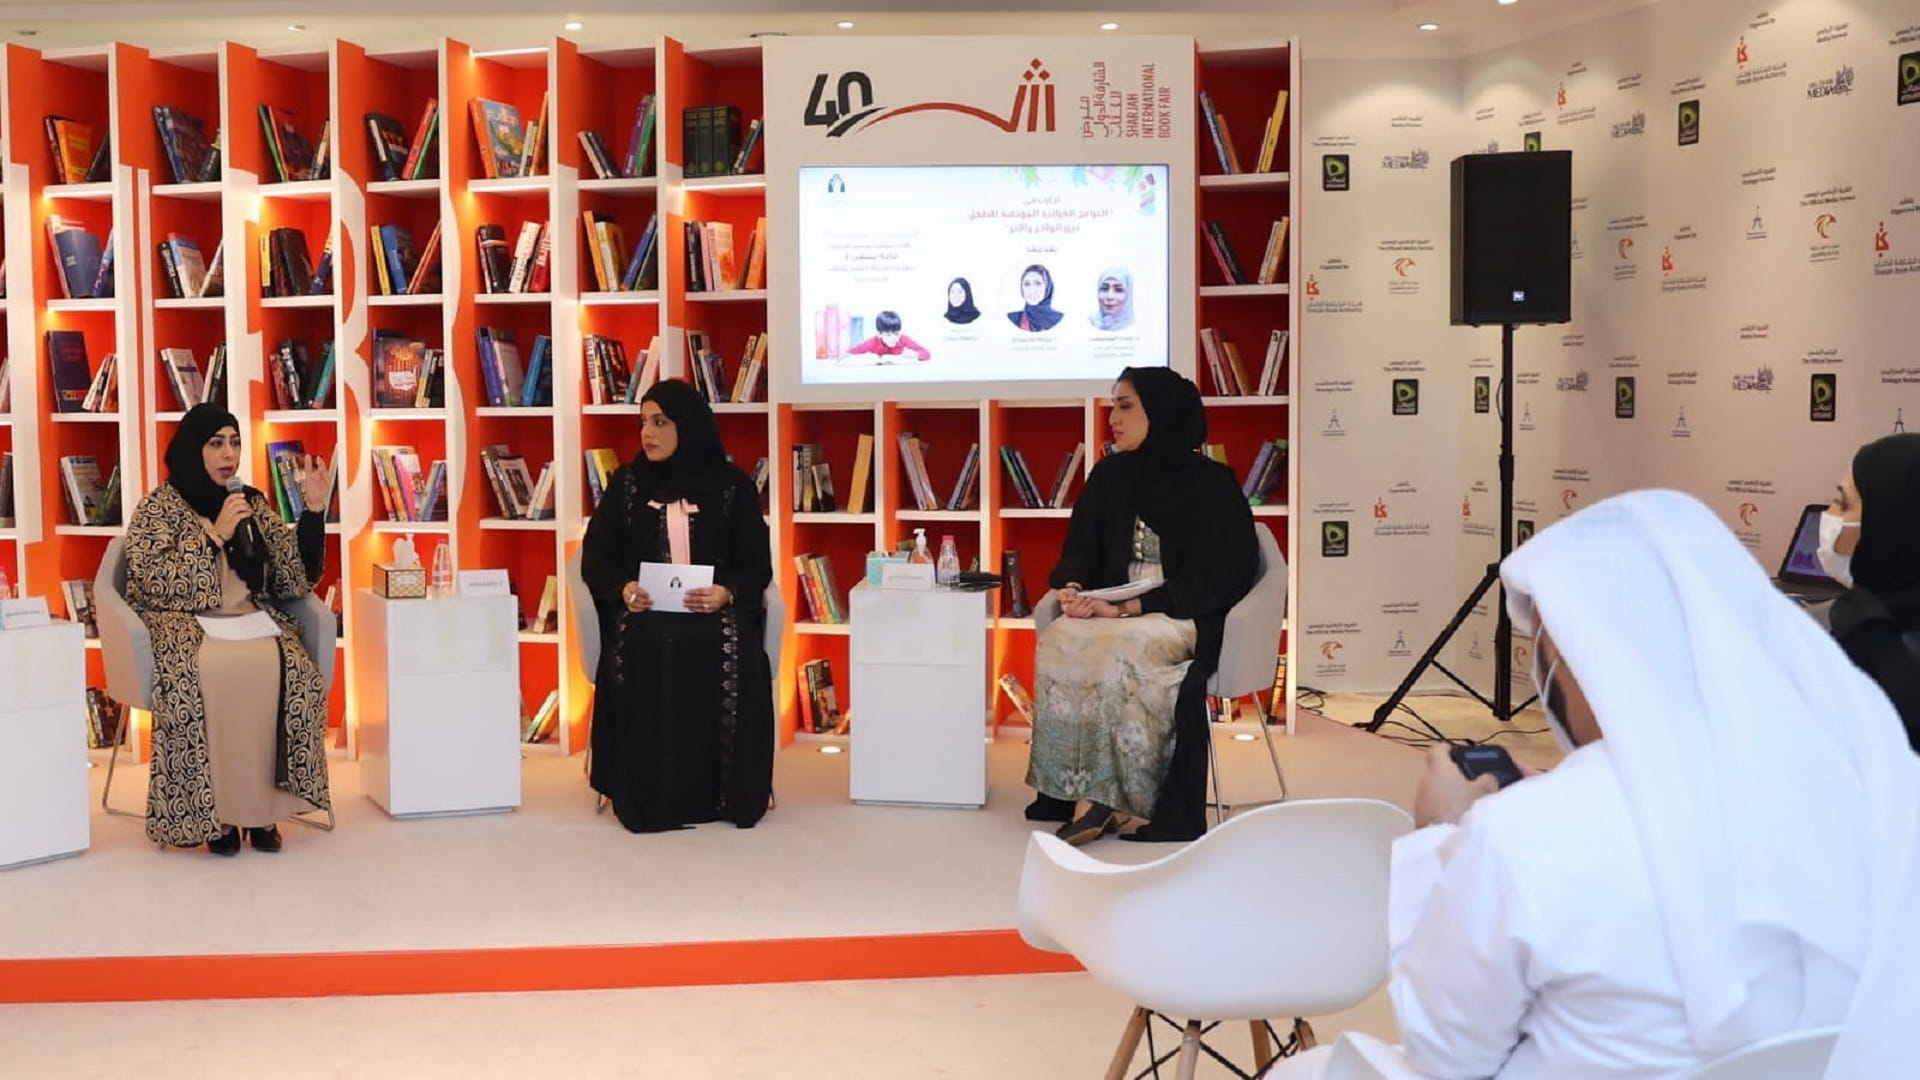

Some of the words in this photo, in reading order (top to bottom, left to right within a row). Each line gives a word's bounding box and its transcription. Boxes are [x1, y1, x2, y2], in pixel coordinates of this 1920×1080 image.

[804, 71, 872, 127] 40
[1126, 93, 1139, 138] SHARJAH
[1141, 62, 1154, 138] INTERNATIONAL
[1158, 87, 1170, 109] FAIR
[1158, 111, 1171, 138] BOOK
